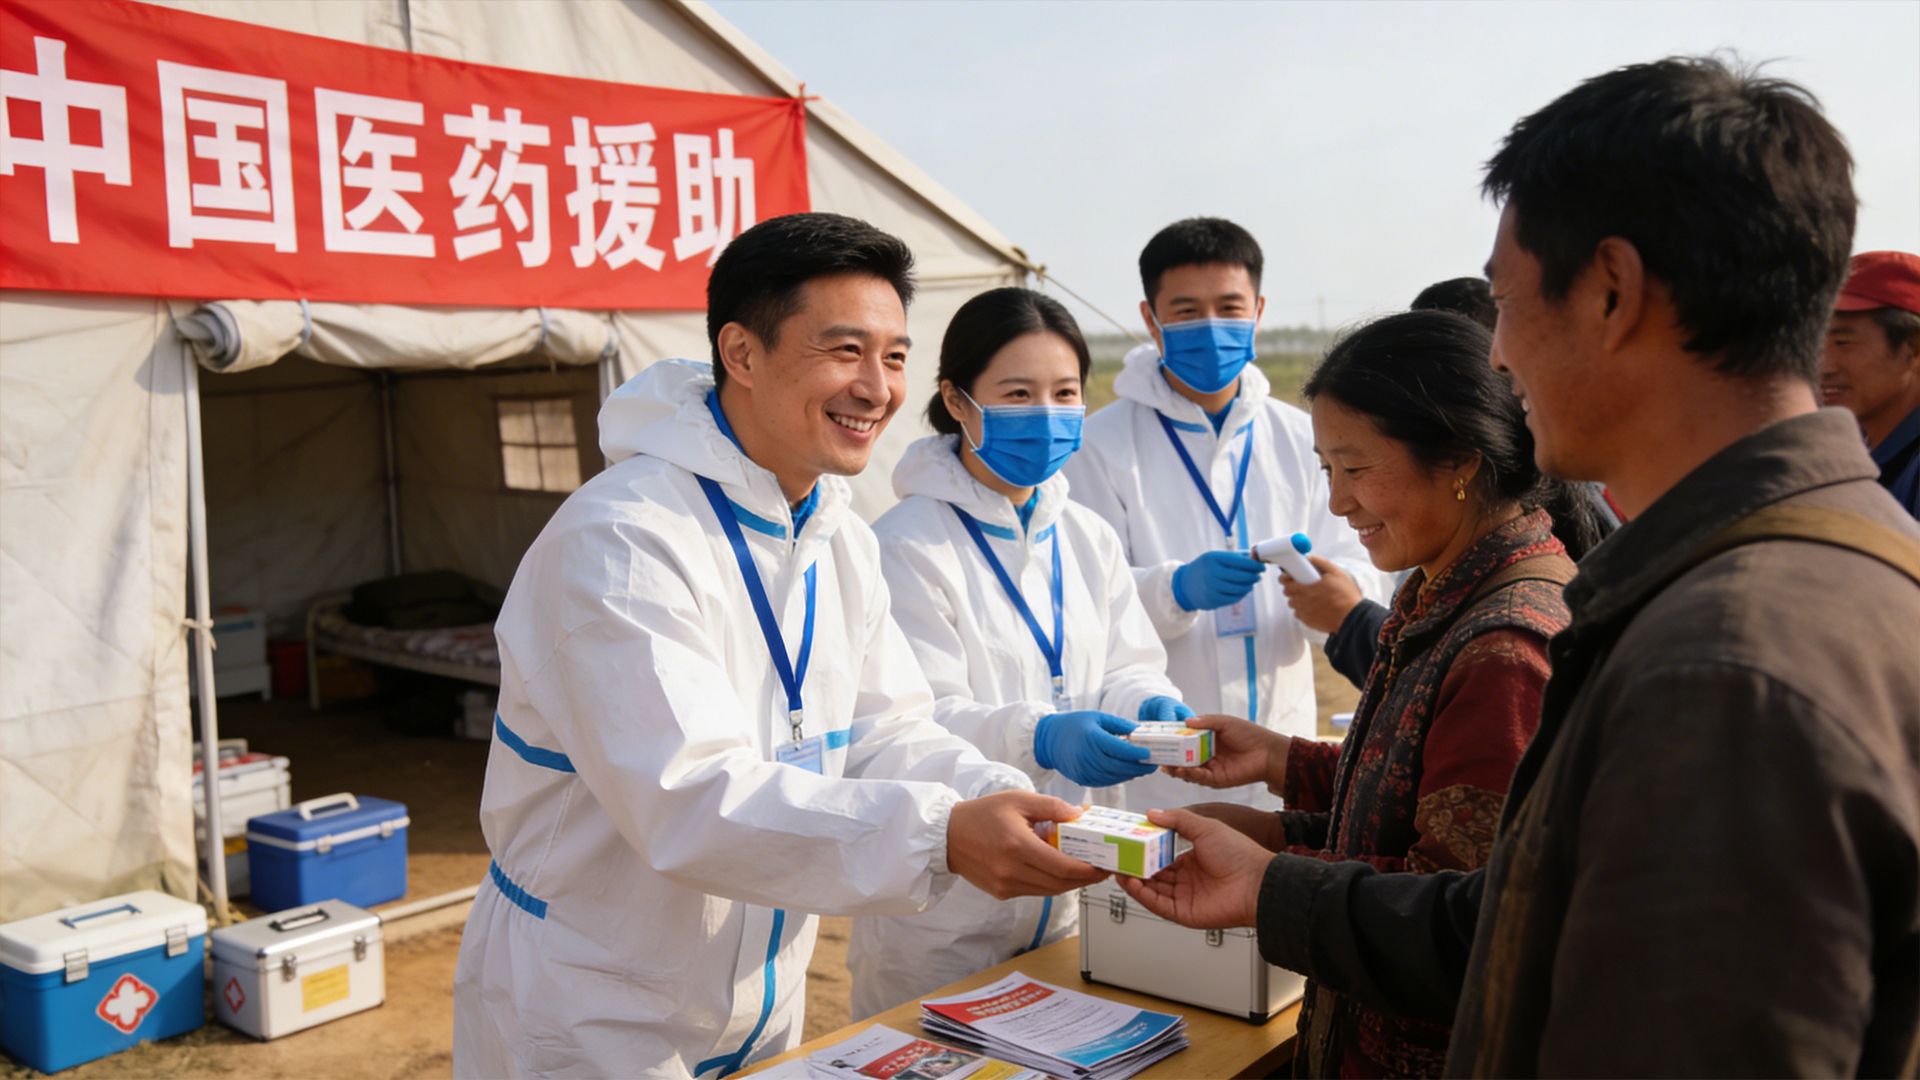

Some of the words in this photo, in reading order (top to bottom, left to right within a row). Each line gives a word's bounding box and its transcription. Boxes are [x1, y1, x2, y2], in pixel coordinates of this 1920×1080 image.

[0, 36, 757, 271] 中国医药援助
